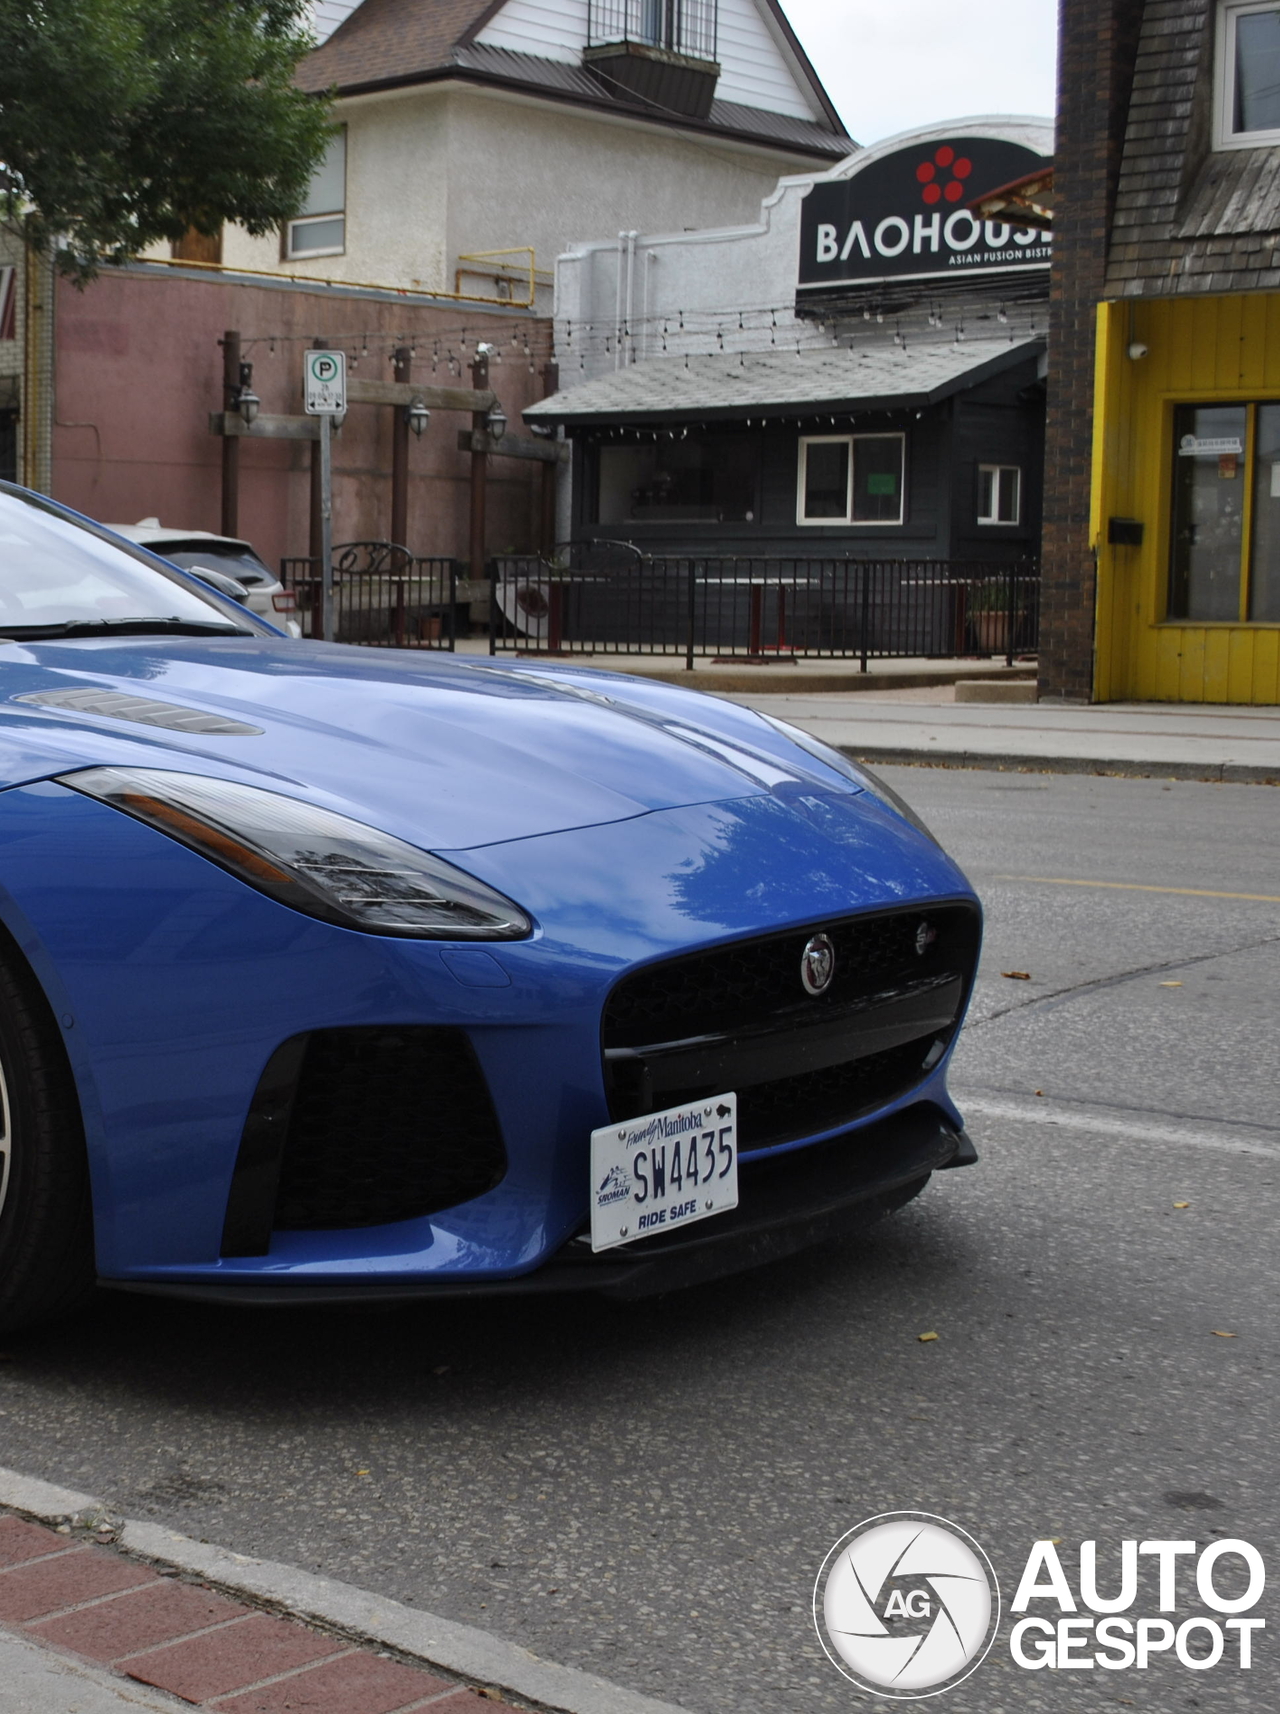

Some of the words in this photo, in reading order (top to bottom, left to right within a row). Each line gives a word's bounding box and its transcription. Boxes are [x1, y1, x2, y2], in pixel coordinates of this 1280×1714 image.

[816, 208, 1053, 263] BAOHOU
[948, 253, 982, 266] ASIAN
[984, 249, 1023, 262] FUSION
[1025, 246, 1053, 259] BISTR
[319, 361, 332, 377] P
[626, 1118, 659, 1149] Friendly
[657, 1111, 703, 1140] Manitoba
[633, 1126, 733, 1204] SW4435
[597, 1186, 631, 1205] SNOMAN
[638, 1208, 666, 1230] RIDE
[669, 1199, 697, 1221] SAFE
